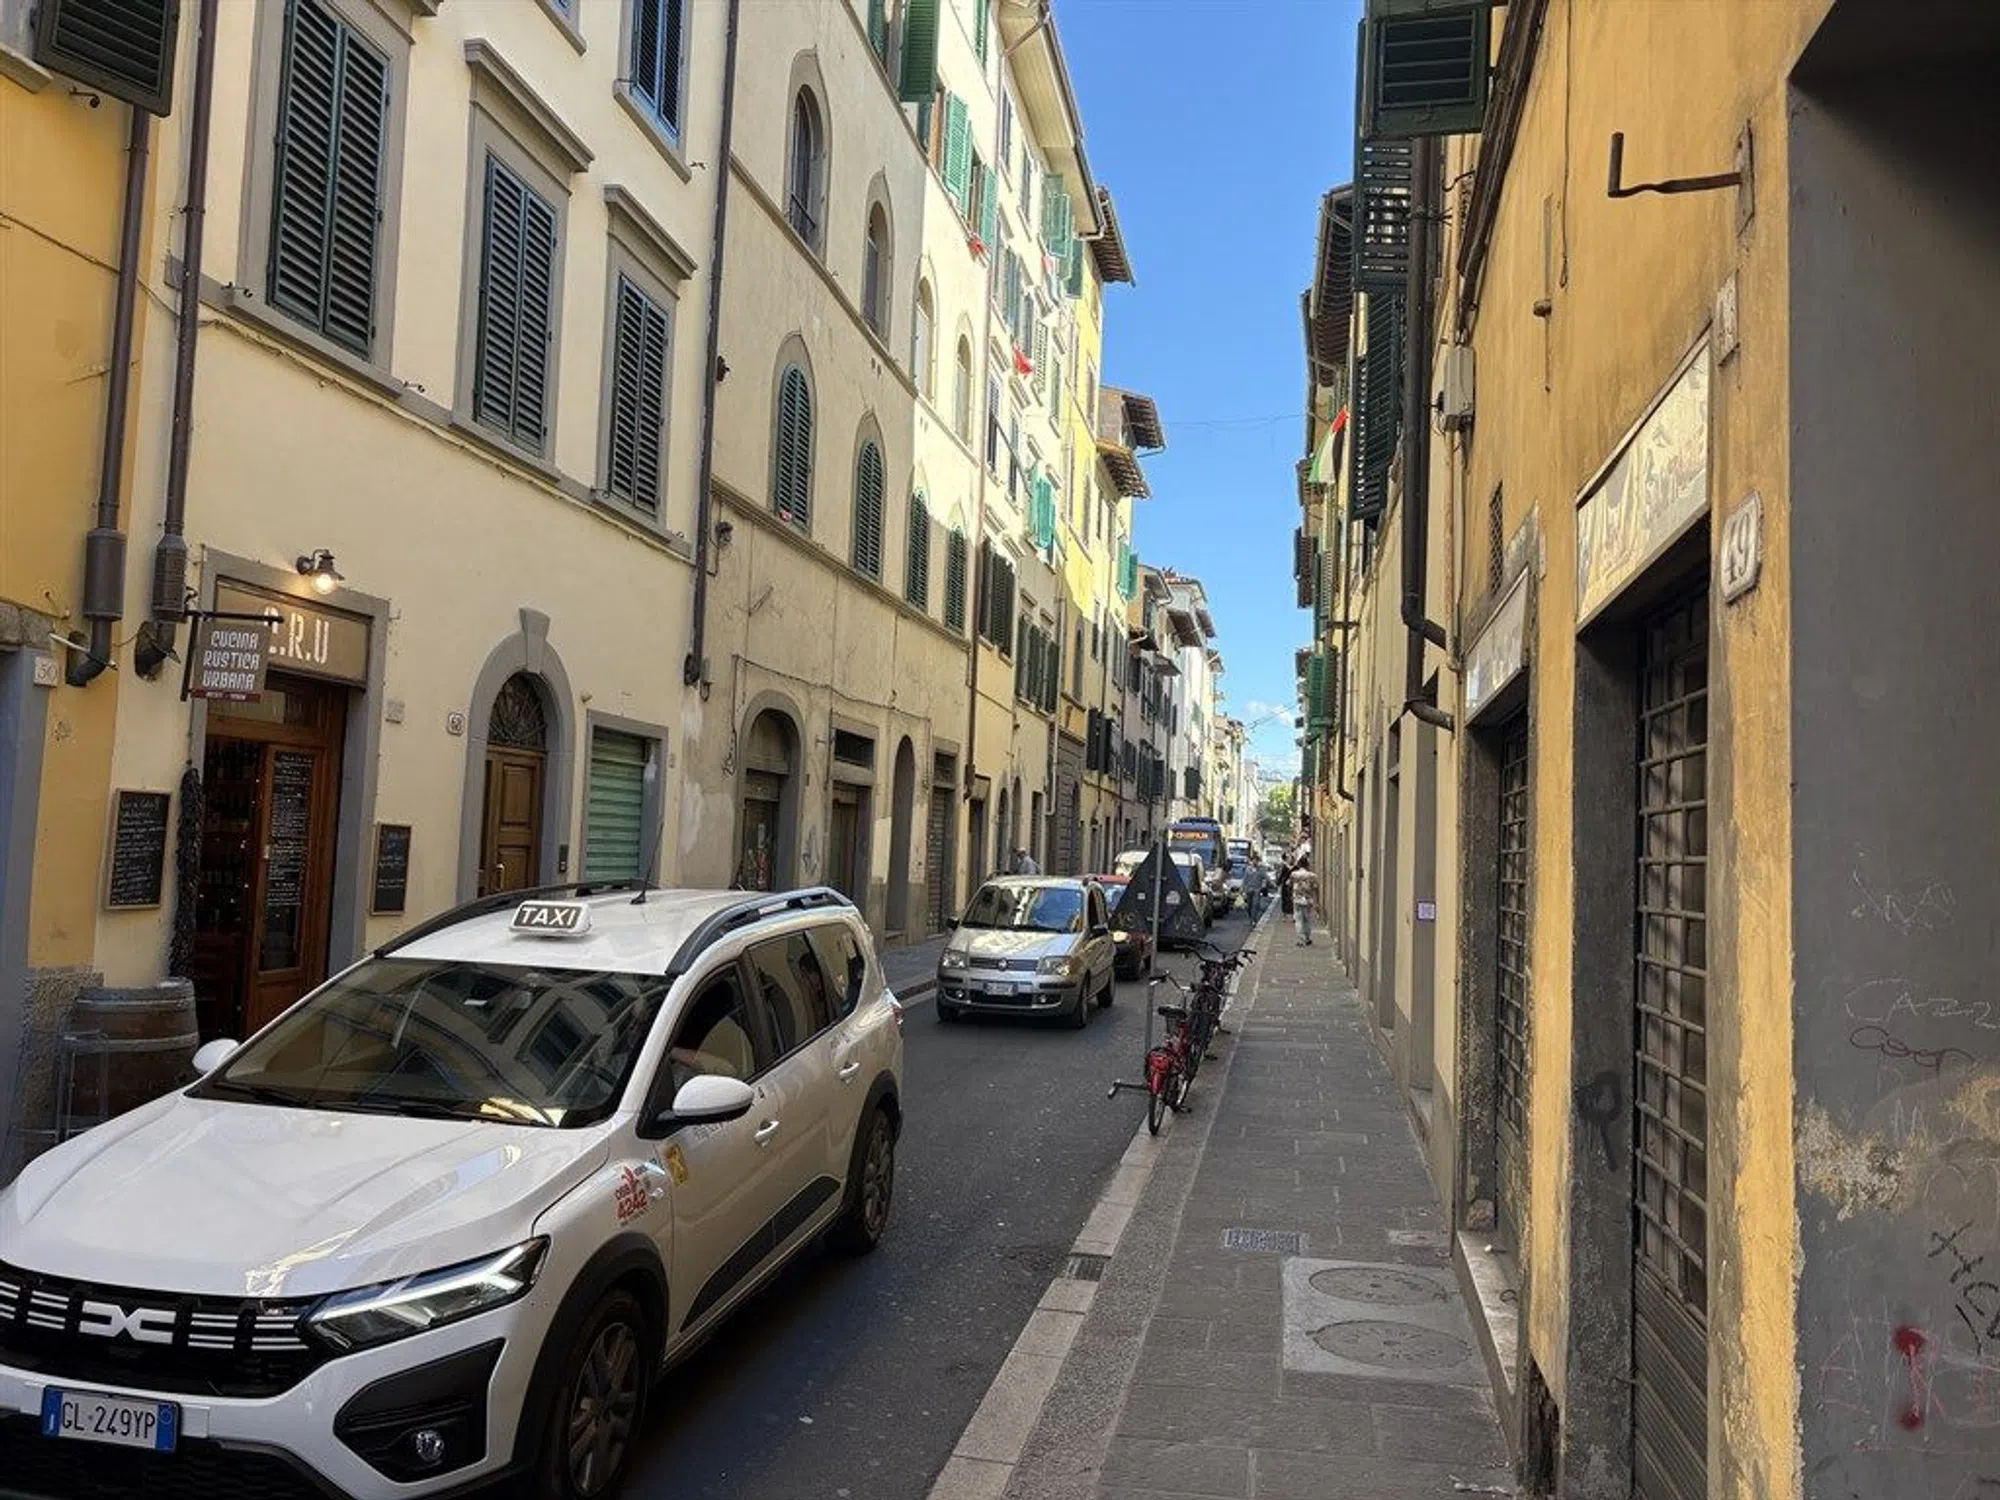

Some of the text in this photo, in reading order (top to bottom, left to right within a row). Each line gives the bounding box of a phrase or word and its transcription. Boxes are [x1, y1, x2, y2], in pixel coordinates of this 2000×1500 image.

[211, 630, 259, 650] CUCINA
[203, 650, 260, 671] RUSTICA
[202, 670, 255, 691] URBANA
[521, 906, 577, 927] TAXI
